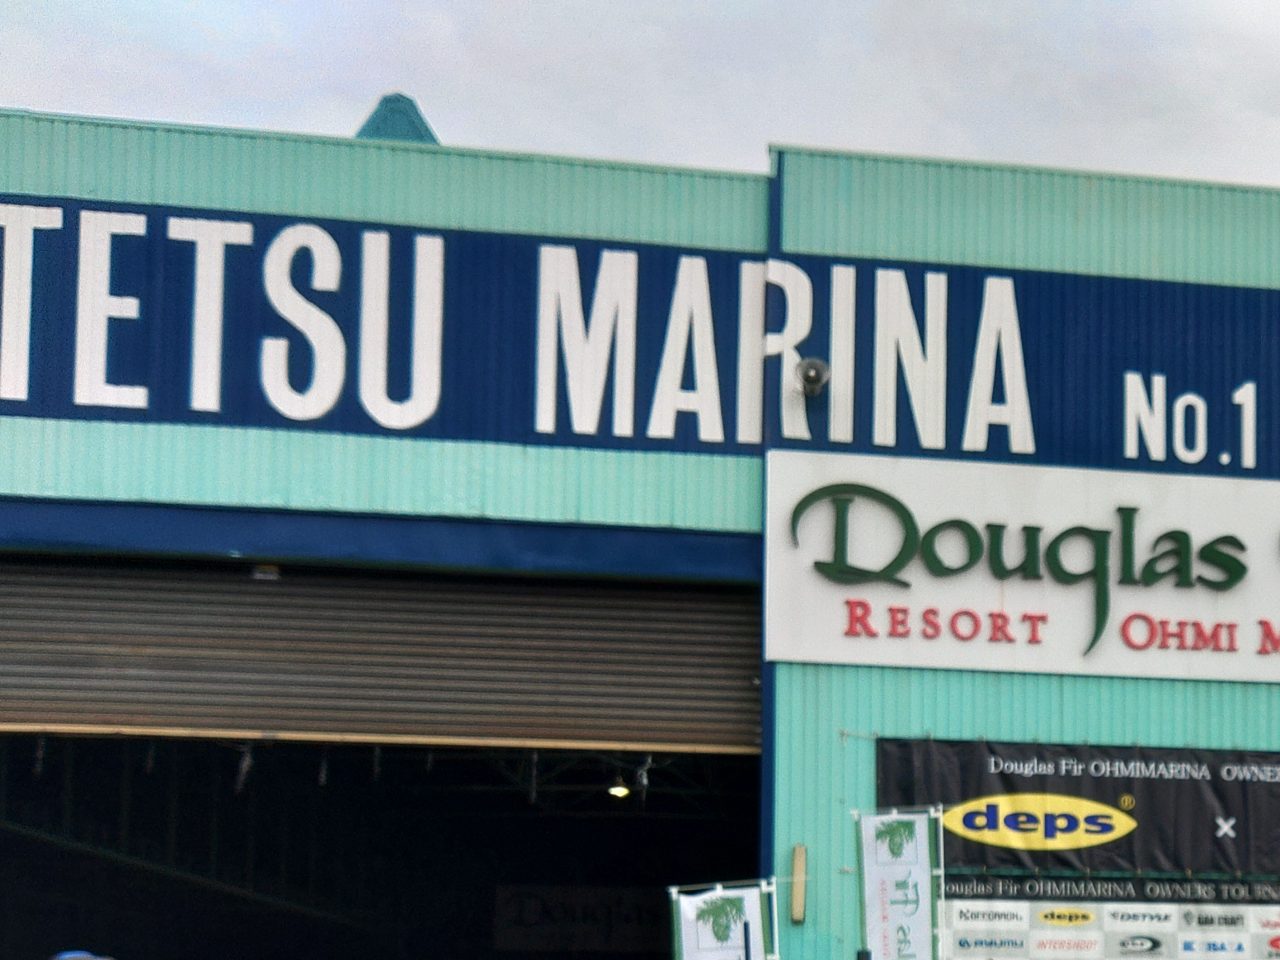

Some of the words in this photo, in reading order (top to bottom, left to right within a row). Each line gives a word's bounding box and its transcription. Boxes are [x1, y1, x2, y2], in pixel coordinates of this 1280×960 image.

[0, 205, 445, 430] TETSU
[535, 244, 1036, 455] MARINA
[1123, 370, 1258, 469] No.1
[790, 482, 1249, 658] Douglas
[844, 598, 1049, 645] RESORT
[1120, 612, 1240, 653] OHMI
[988, 756, 1055, 777] Douglas
[1059, 759, 1085, 776] Fir
[1088, 759, 1211, 781] OHMIMARINA
[961, 803, 1116, 840] deps
[946, 878, 994, 897] ouglas
[998, 878, 1022, 894] Fir
[1025, 878, 1137, 898] OHMIMARINA
[1143, 881, 1217, 900] OWNERS
